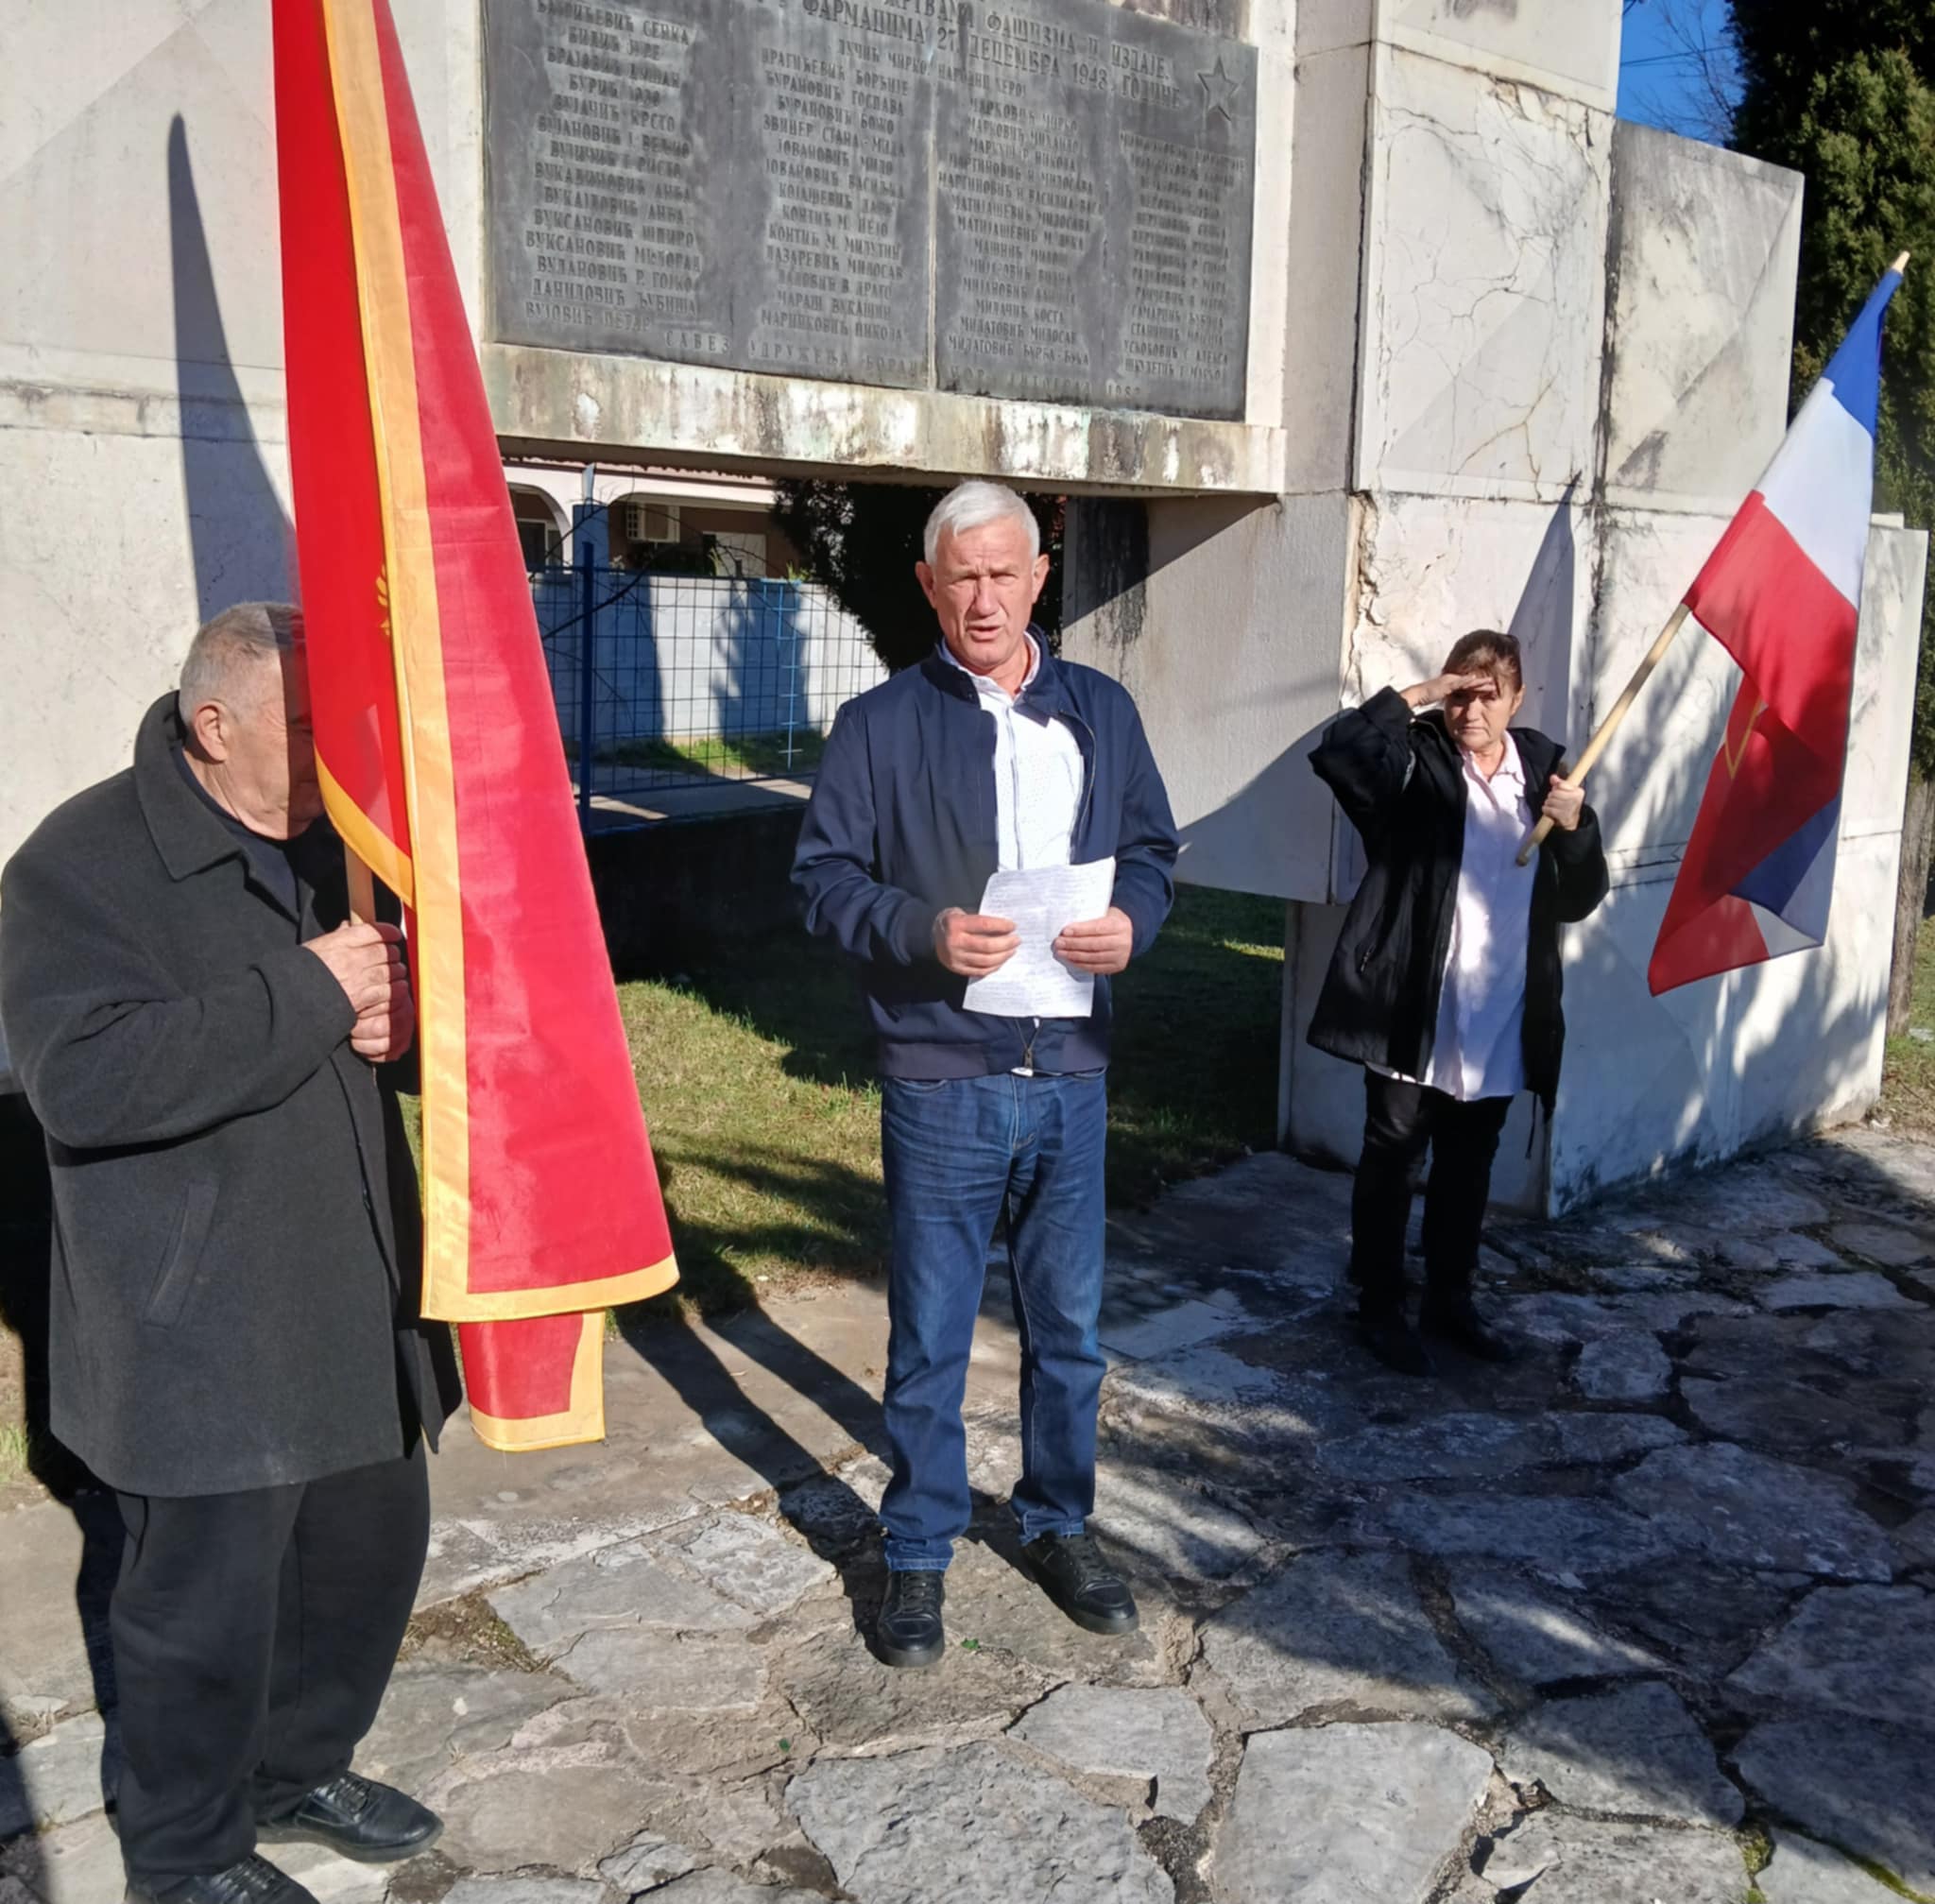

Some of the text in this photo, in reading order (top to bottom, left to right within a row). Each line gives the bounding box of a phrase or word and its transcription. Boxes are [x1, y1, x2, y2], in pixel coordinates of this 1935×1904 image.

[642, 18, 687, 43] СЕНКА
[986, 9, 1075, 54] ФАШИЗМА
[801, 0, 923, 43] ФАРМАЦИМА
[968, 34, 1059, 77] ДЕЦЕМБРА
[1122, 74, 1179, 110] ГОДИНЕ
[851, 90, 903, 116] ГОСПАВА
[536, 114, 620, 145] ВУЈАНОВИЋ
[630, 109, 675, 131] КРСТО
[762, 112, 812, 138] ЗВИЦЕР
[860, 111, 894, 134] БОЖО
[778, 138, 849, 166] ЈОВАНОВИЋ
[765, 157, 838, 186] ЈОВАНОВИЋ
[533, 207, 694, 248] ВУКСАНОВИЋ ШПИРО
[782, 204, 831, 227] КОНТИЋ
[858, 217, 887, 237] ПЕЈО
[524, 230, 625, 260] ВУКСАНОВИЋ
[769, 223, 818, 246] КОНТИЋ
[845, 236, 900, 262] МИЛУТИН
[536, 255, 626, 283] ВУЛАНОВИЋ
[652, 271, 693, 292] ГОЈКО
[766, 245, 902, 281] ЛАЗАРЕВИЋ МИЛОСАВ
[531, 278, 625, 306] ДАНИЛОВИЋ
[525, 300, 592, 325] ВУЈОВИЋ
[831, 297, 891, 320] ВУКАШИН
[1034, 306, 1064, 324] КОСТА
[855, 321, 901, 342] НИКОЛА
[949, 334, 1014, 357] МИЛАТОВИЋ
[665, 330, 729, 353] САВЕЗ
[749, 339, 848, 367] УДРУЖЕЊА
